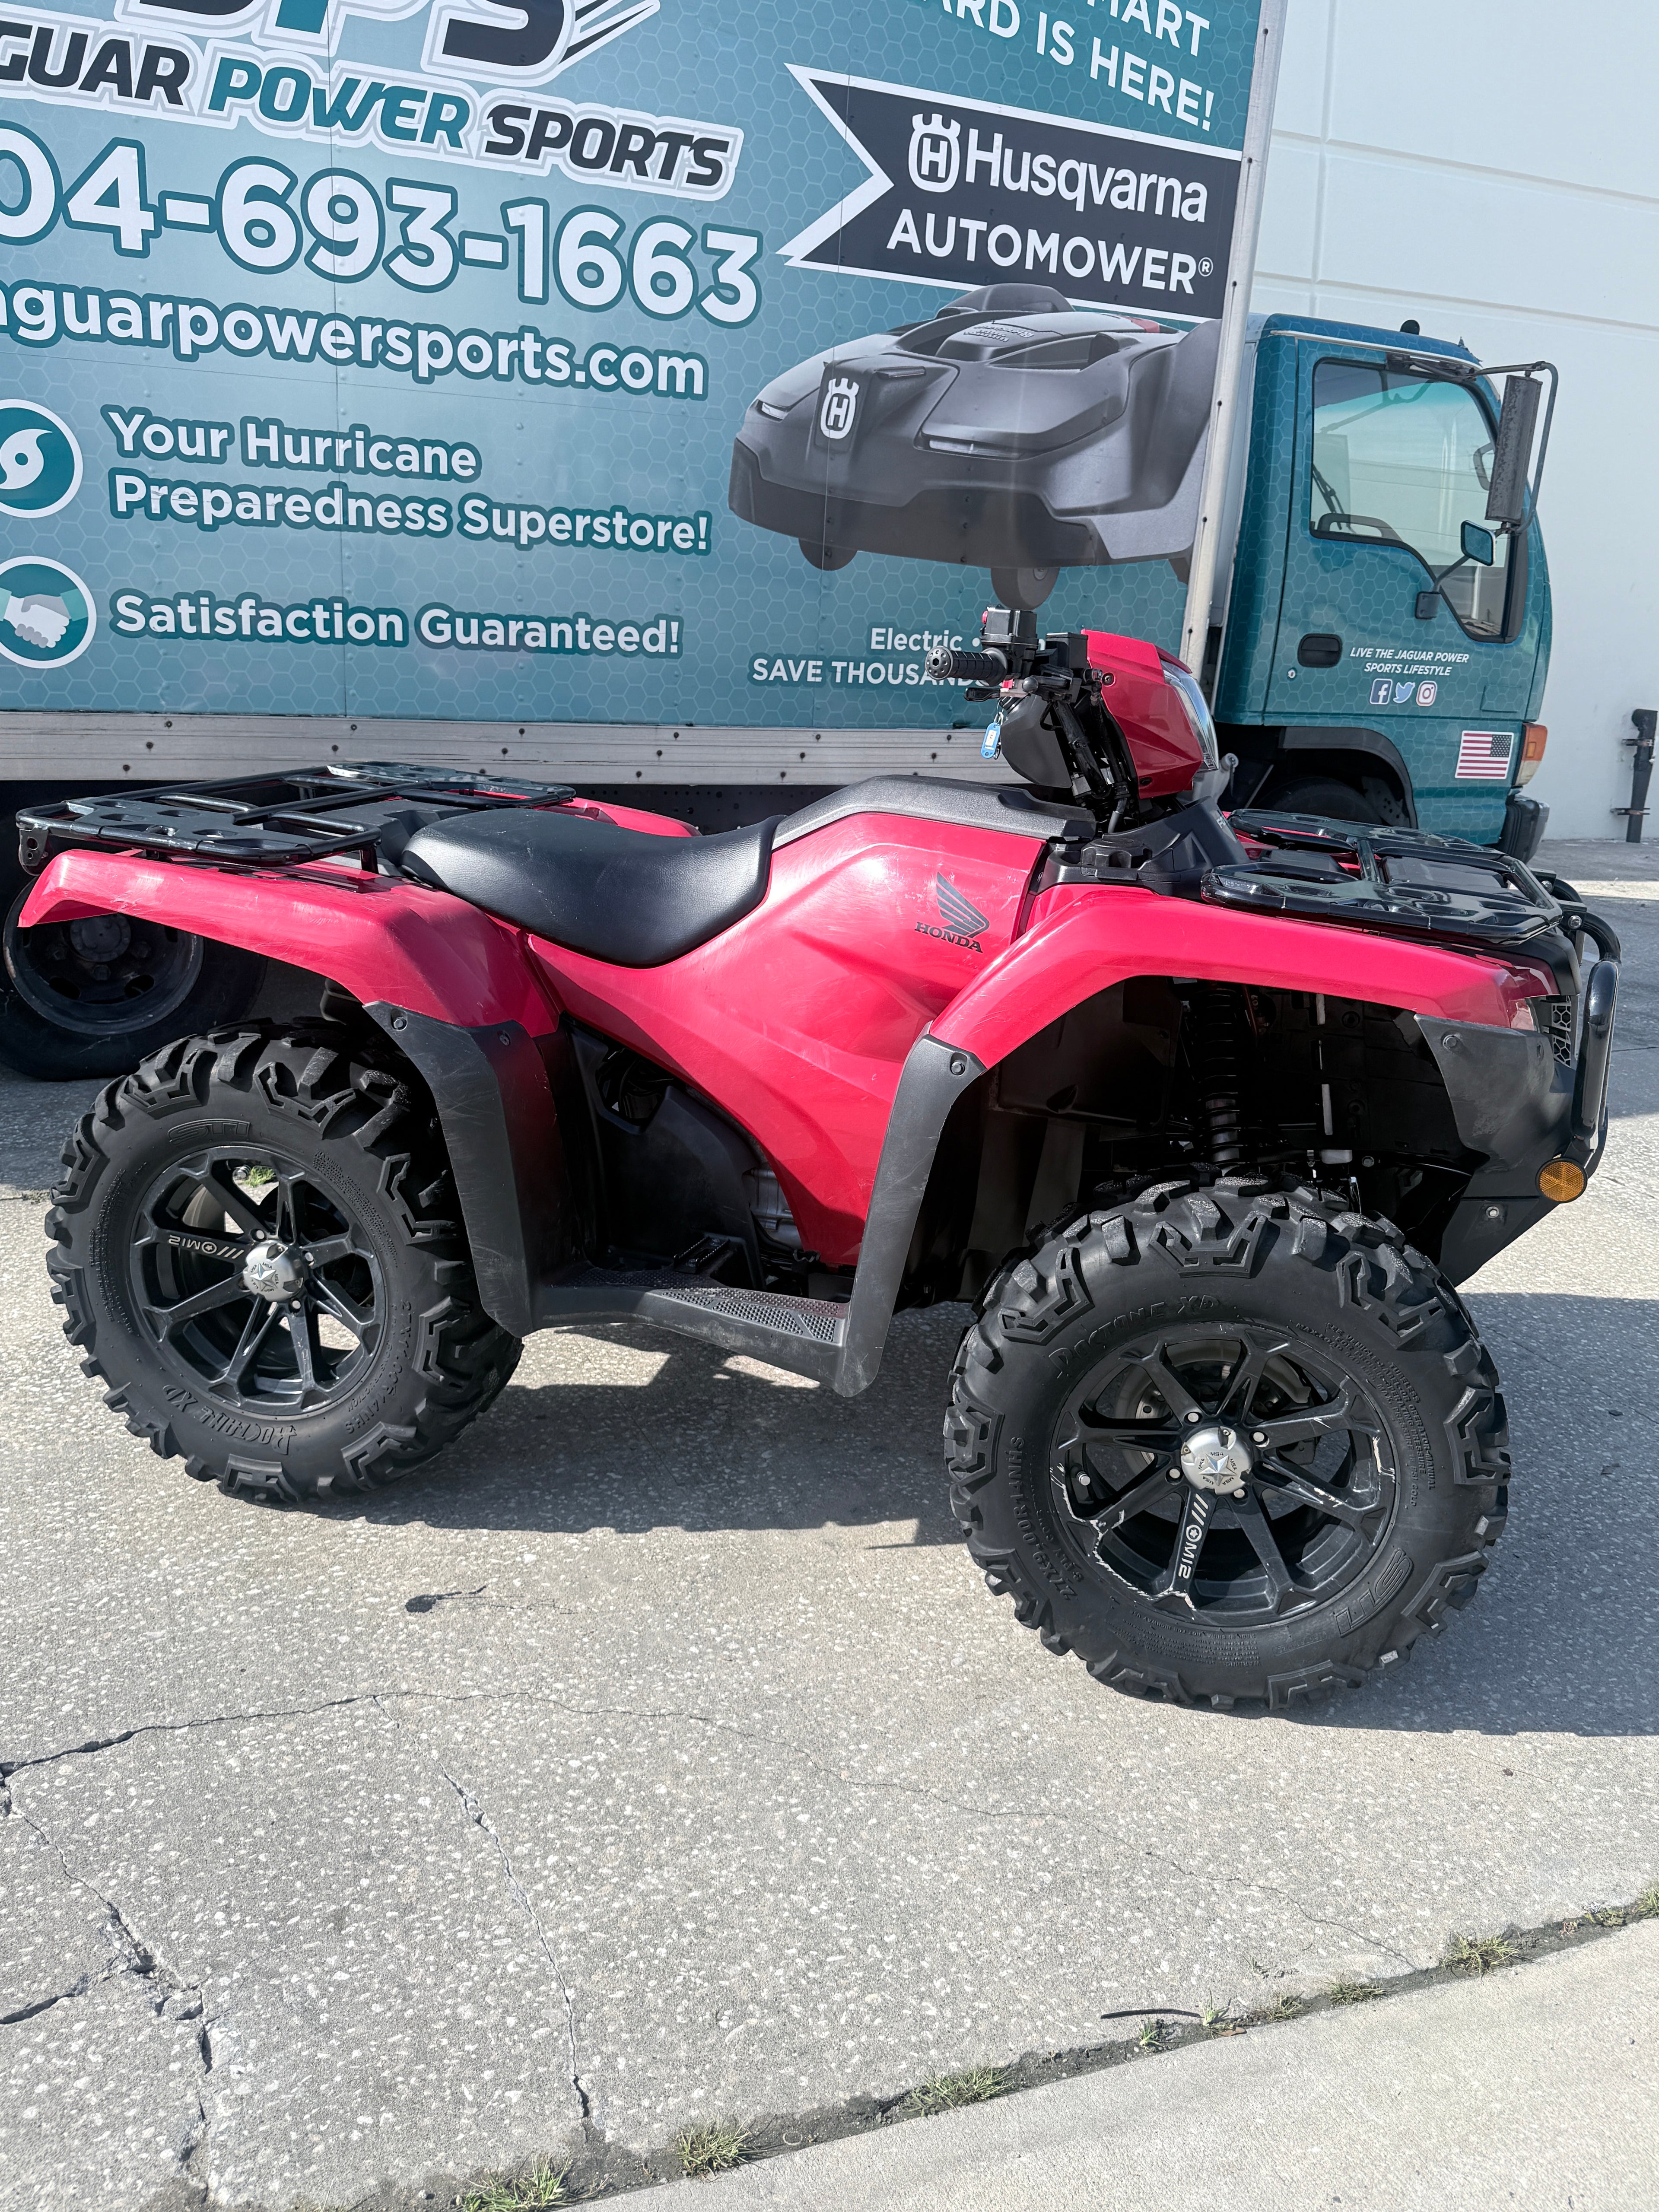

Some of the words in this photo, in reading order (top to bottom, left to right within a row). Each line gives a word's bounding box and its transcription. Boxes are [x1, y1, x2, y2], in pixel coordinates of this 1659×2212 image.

[1037, 12, 1075, 65] IS
[1090, 36, 1214, 131] HERE!
[208, 57, 470, 149] POWER
[484, 103, 730, 186] SPORTS
[966, 128, 1208, 222] Husqvarna
[0, 286, 704, 395] guarpowersports.com
[108, 412, 228, 458] Your
[247, 423, 477, 477] Hurricane
[115, 475, 448, 532] Preparedness
[464, 499, 708, 550] Superstore!
[116, 594, 404, 641] Satisfaction
[420, 609, 679, 654] Guaranteed!
[871, 627, 962, 652] Electric
[753, 659, 823, 683] SAVE
[832, 661, 986, 686] THOUS
[1350, 647, 1373, 658] LIVE
[1375, 649, 1395, 658] THE
[1394, 650, 1434, 661] JAGUAR
[1434, 652, 1469, 663] POWER
[1364, 662, 1402, 674] SPORTS
[1403, 664, 1452, 676] LIFESTYLE
[914, 922, 983, 953] HONDA
[1387, 1361, 1422, 1404] TUBELESS
